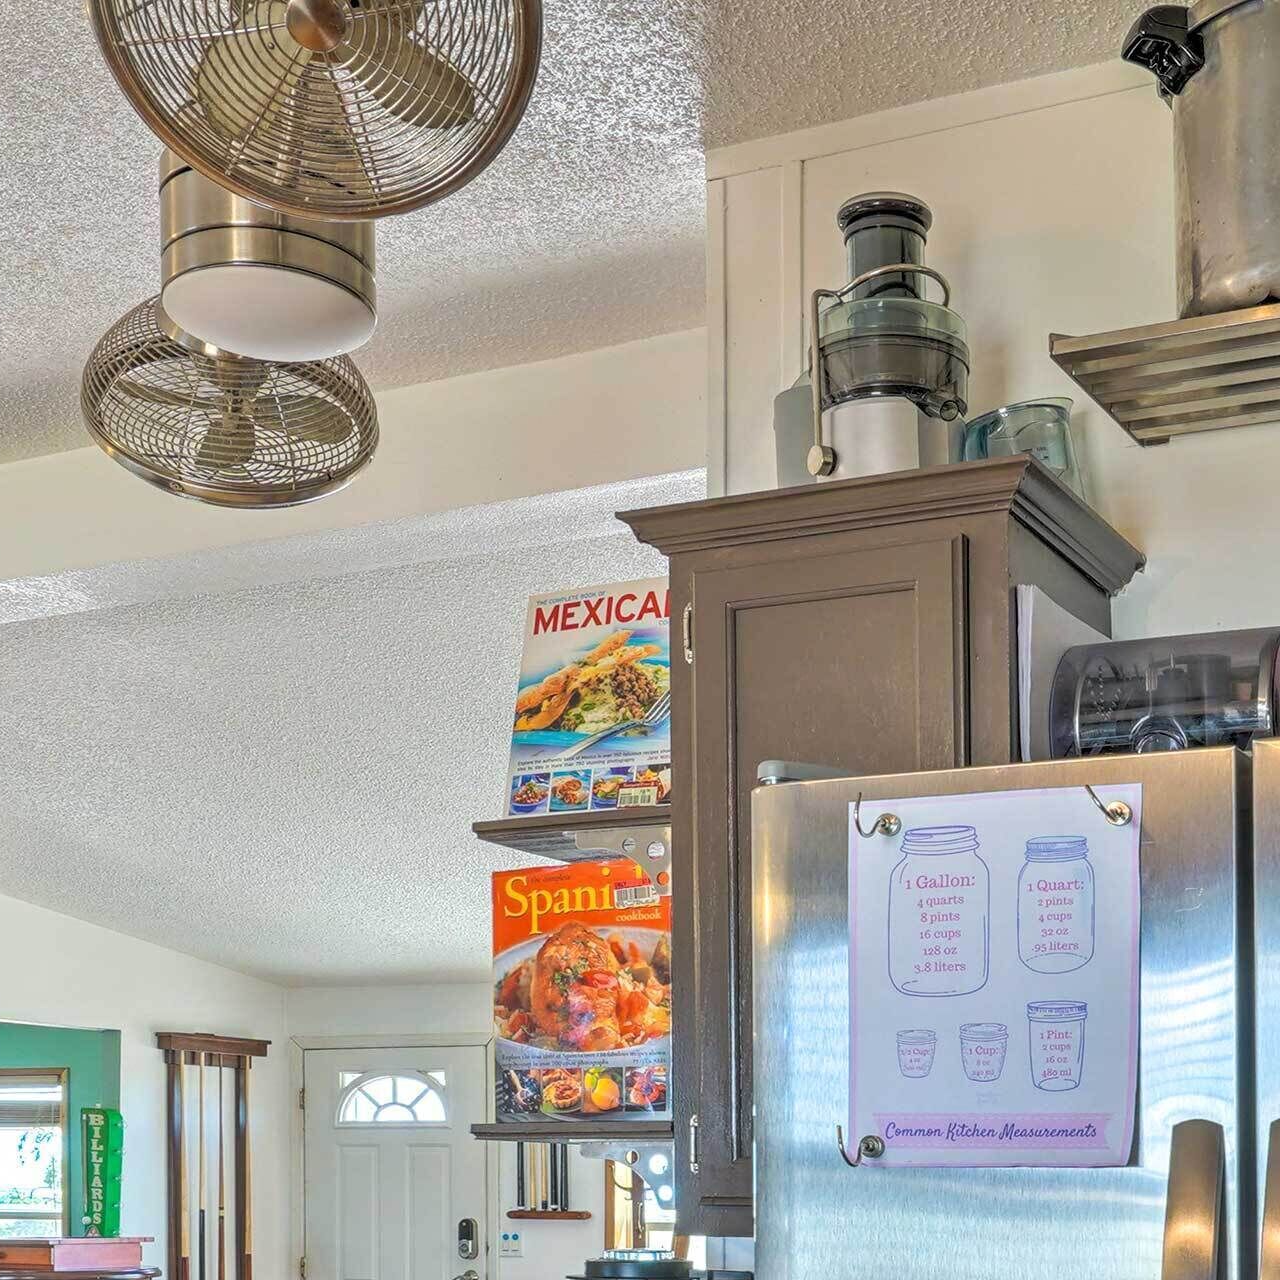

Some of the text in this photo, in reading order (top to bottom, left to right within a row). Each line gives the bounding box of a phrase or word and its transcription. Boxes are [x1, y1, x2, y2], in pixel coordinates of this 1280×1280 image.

[905, 873, 976, 890] 1 Gallon:
[1027, 879, 1085, 893] 1 Quart:
[504, 864, 660, 935] Spani
[917, 895, 965, 909] 4 quarts
[1037, 896, 1074, 908] 2 pints
[615, 908, 662, 922] cookbook
[920, 911, 961, 924] 8 pints
[1038, 912, 1073, 923] 4 cups
[919, 929, 961, 940] 16 cups
[1041, 927, 1070, 937] 32 oz
[923, 945, 958, 956] 128 oz
[1031, 941, 1080, 953] .95 liters
[913, 961, 966, 974] 3.8 liters
[1047, 1029, 1073, 1040] Pint:
[975, 1045, 999, 1057] Cup:
[1049, 1043, 1072, 1052] cups
[1046, 1055, 1068, 1064] 16 oz
[1059, 1067, 1072, 1077] ml
[885, 1121, 1097, 1142] Common Kitchen Measurements
[87, 1112, 105, 1226] BILLIARDS
